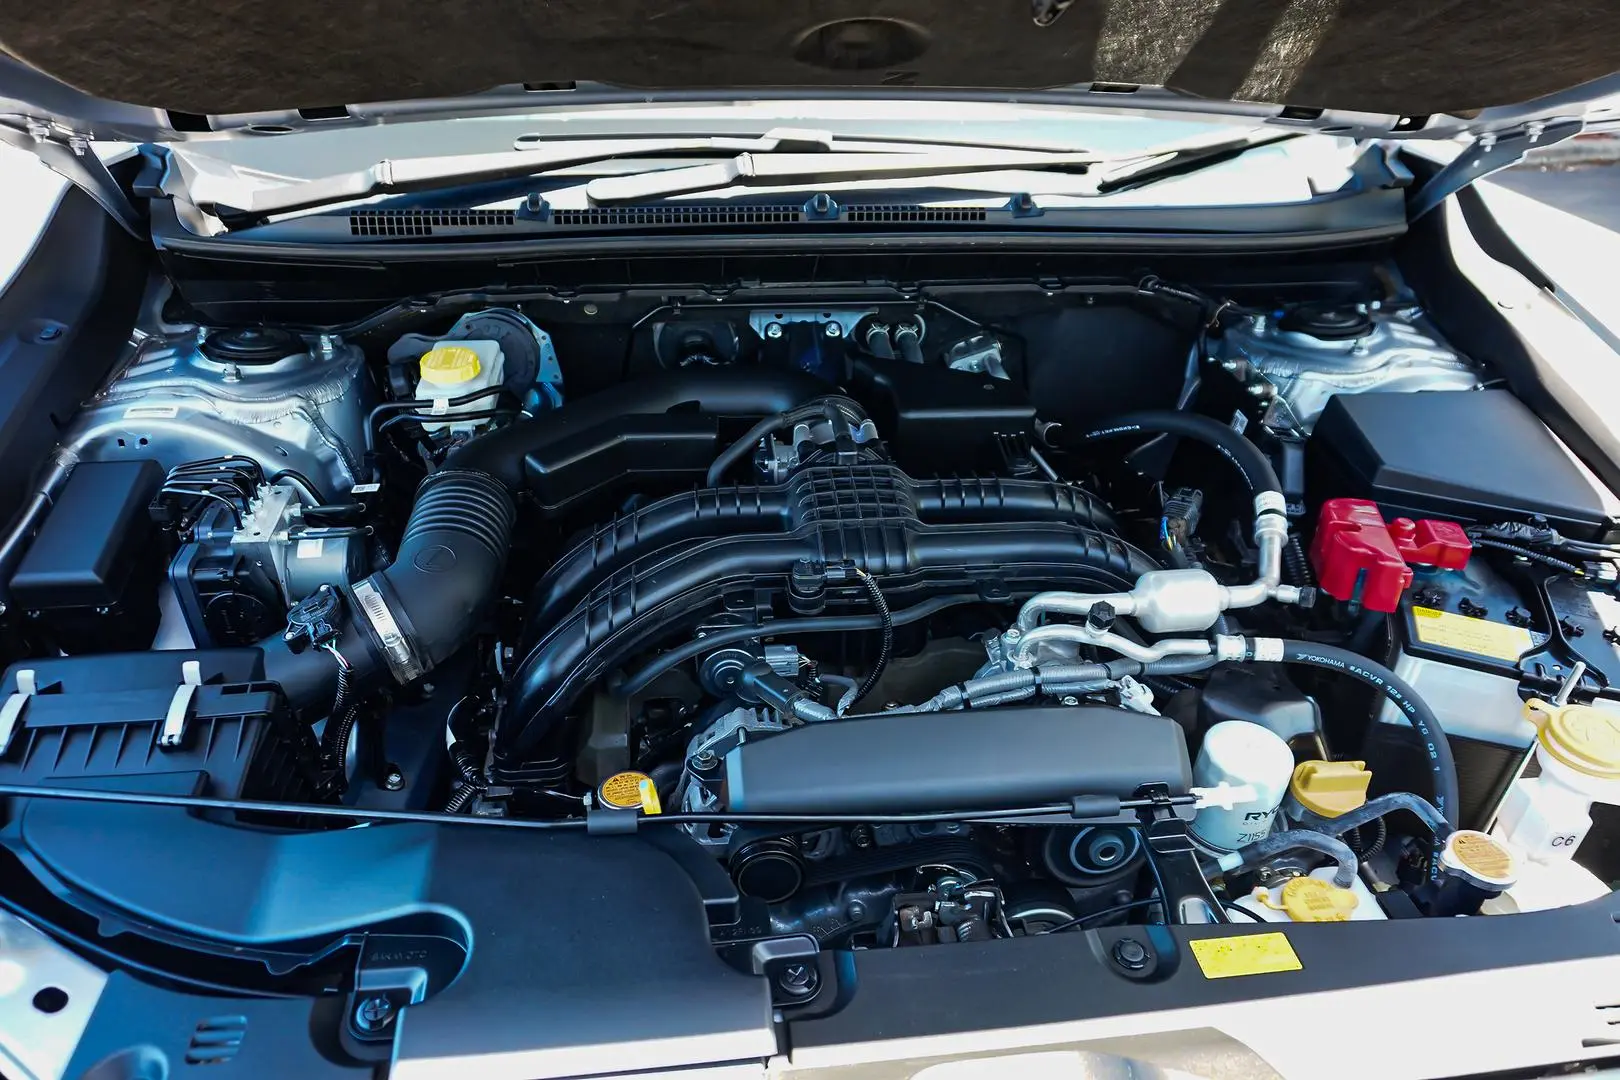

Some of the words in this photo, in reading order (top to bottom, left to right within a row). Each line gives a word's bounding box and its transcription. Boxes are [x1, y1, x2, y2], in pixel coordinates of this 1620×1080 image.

[1307, 655, 1345, 668] YOKOHAMA
[1402, 700, 1416, 713] HP
[1551, 835, 1576, 847] C6
